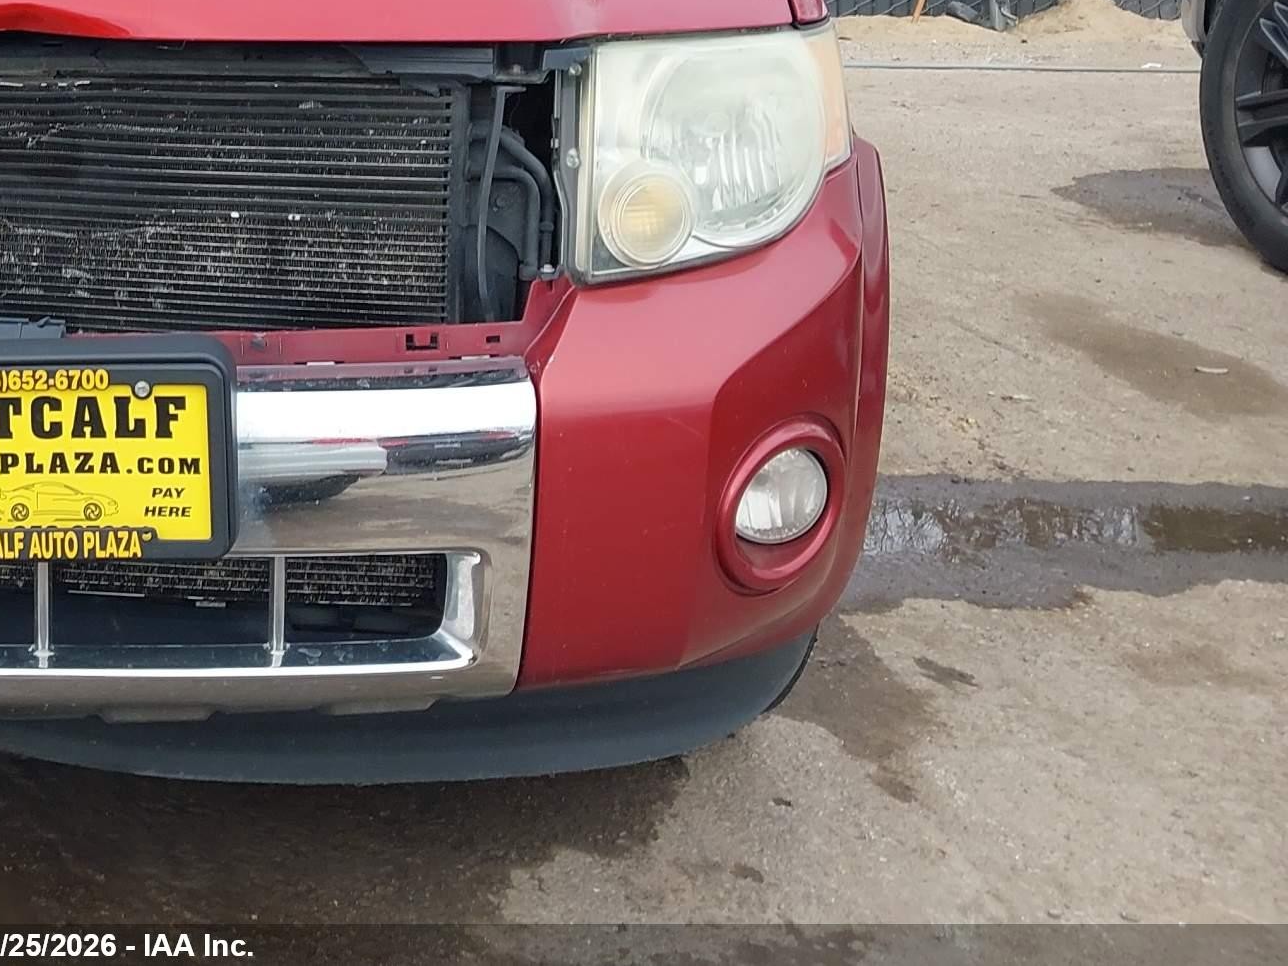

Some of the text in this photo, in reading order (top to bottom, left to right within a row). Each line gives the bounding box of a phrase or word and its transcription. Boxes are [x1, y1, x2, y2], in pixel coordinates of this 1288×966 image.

[151, 487, 186, 499] PAY
[143, 506, 192, 518] HERE
[29, 533, 80, 560] AUTO
[83, 531, 143, 559] PLAZA
